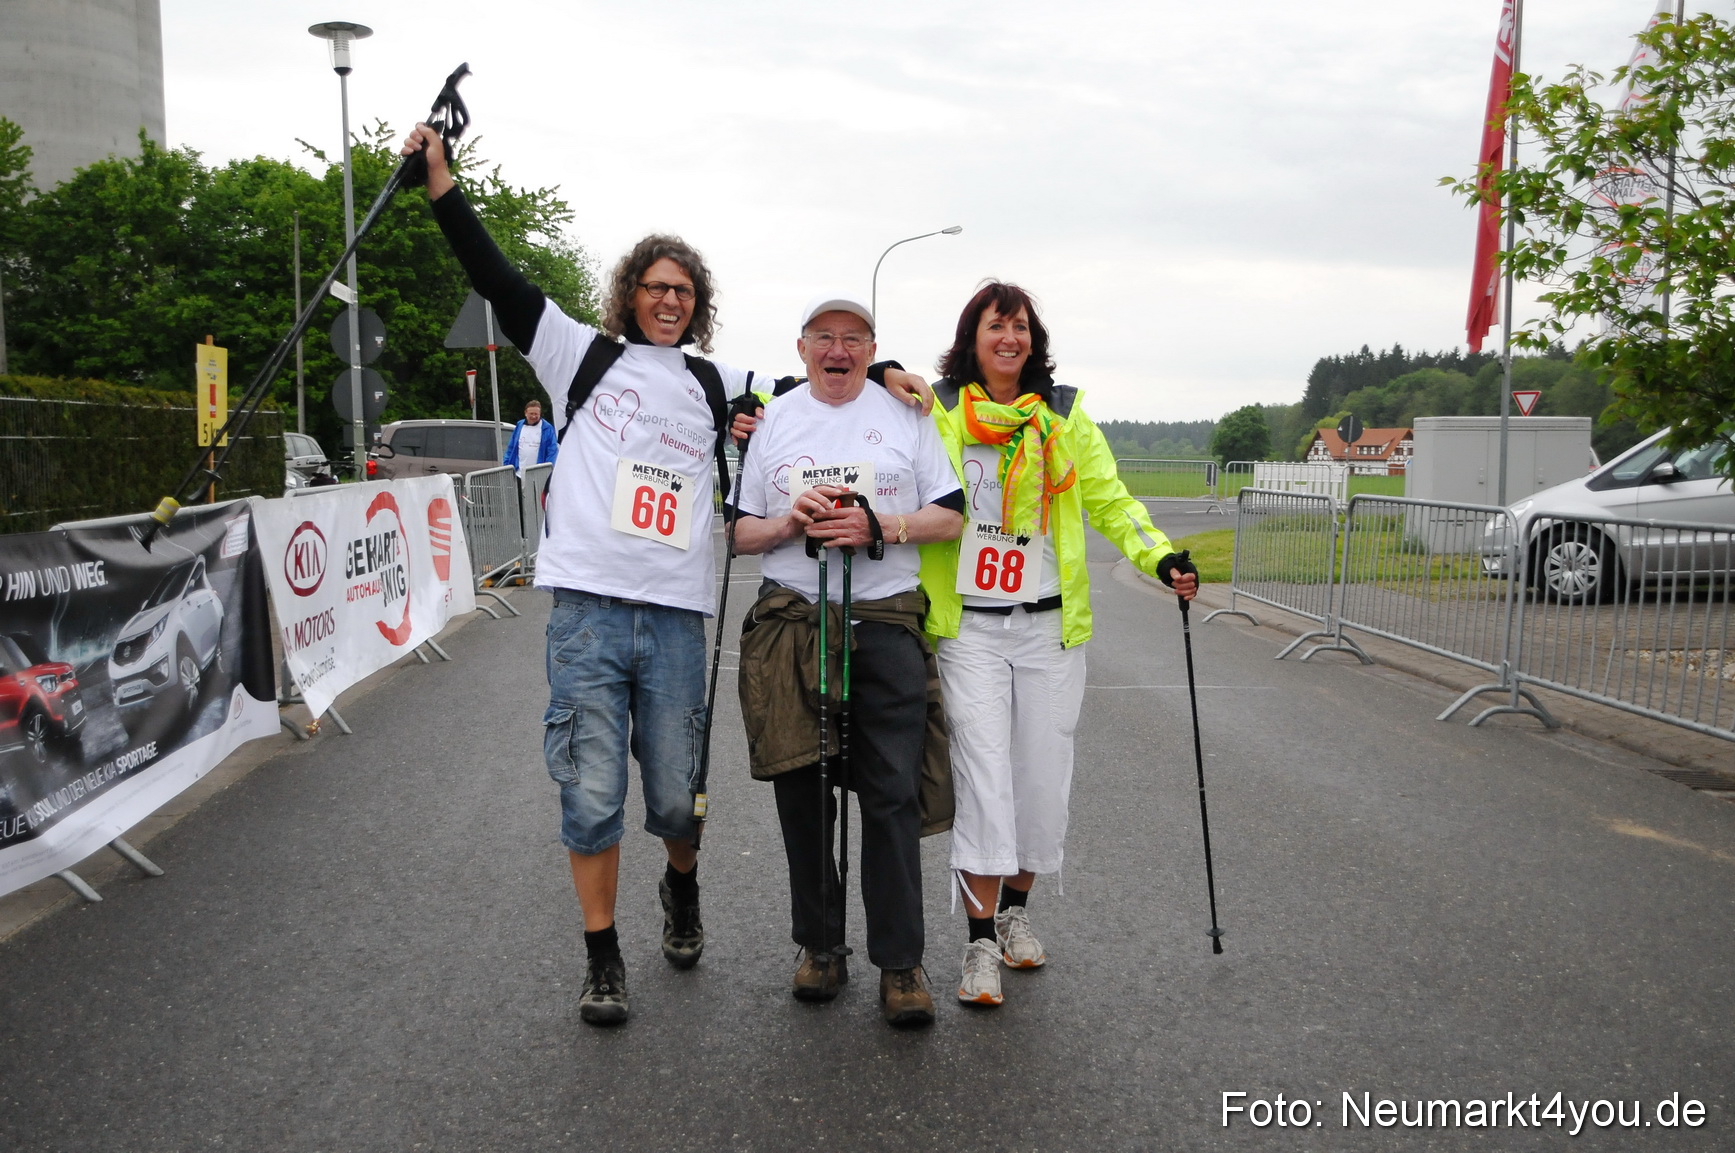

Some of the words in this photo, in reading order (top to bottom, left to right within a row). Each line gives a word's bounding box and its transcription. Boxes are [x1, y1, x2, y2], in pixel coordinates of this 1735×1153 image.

[203, 422, 209, 444] 5
[600, 404, 625, 419] Herz
[636, 411, 668, 428] Sport
[676, 422, 707, 447] Gruppe
[660, 432, 706, 462] Neumarkt
[632, 464, 670, 480] MEYER
[632, 472, 669, 487] WERBUNG
[776, 475, 789, 485] He
[802, 467, 841, 479] MEYER
[802, 476, 842, 486] WERBUNG
[983, 479, 1003, 491] Spo
[631, 485, 678, 537] 66
[976, 523, 1015, 536] MEY
[976, 533, 1014, 543] WERBUNG
[294, 540, 321, 581] KIA
[975, 546, 1025, 594] 68
[5, 570, 37, 602] HIN
[37, 565, 71, 597] UND
[71, 560, 109, 590] WEG.
[346, 578, 384, 604] AUTOHAU
[294, 606, 336, 652] MOTORS
